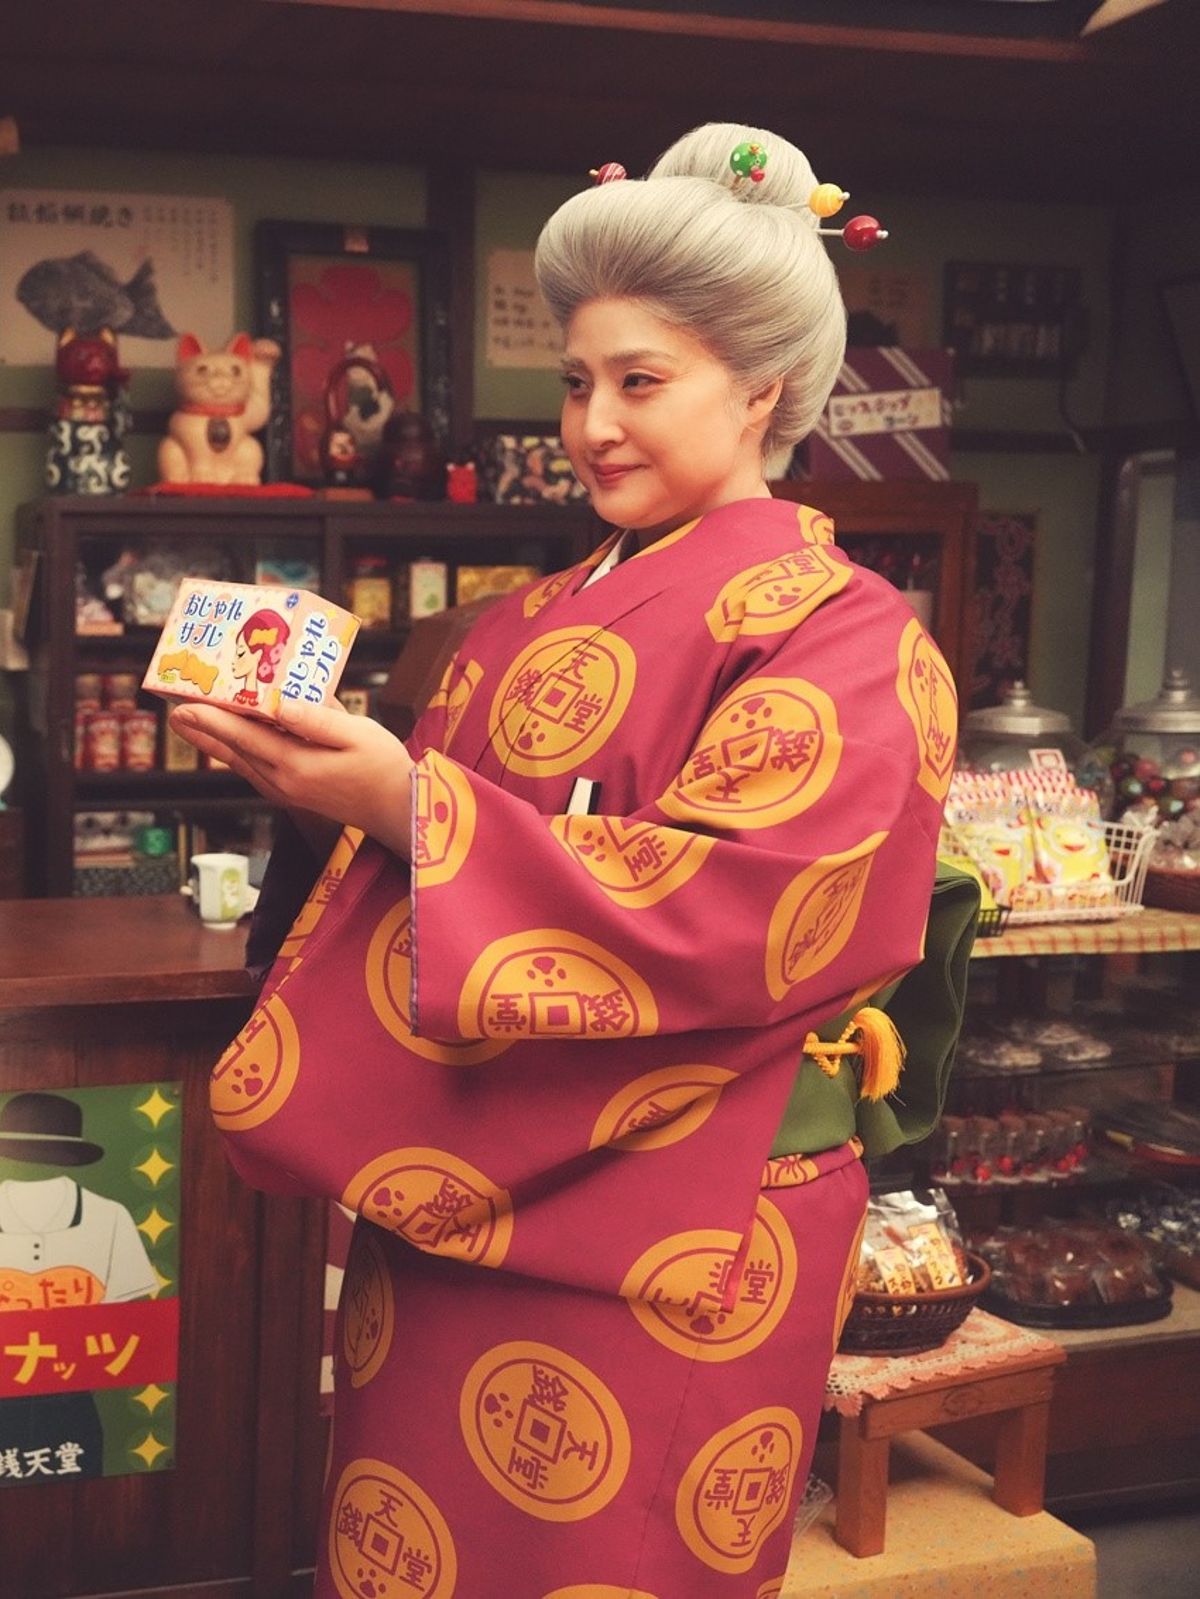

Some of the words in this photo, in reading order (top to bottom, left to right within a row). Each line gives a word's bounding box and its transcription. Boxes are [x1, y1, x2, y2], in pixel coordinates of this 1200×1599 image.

[184, 593, 242, 621] おしゃれ
[180, 623, 223, 648] サブレ
[282, 616, 327, 700] おしゃれ
[305, 640, 340, 703] サブレ
